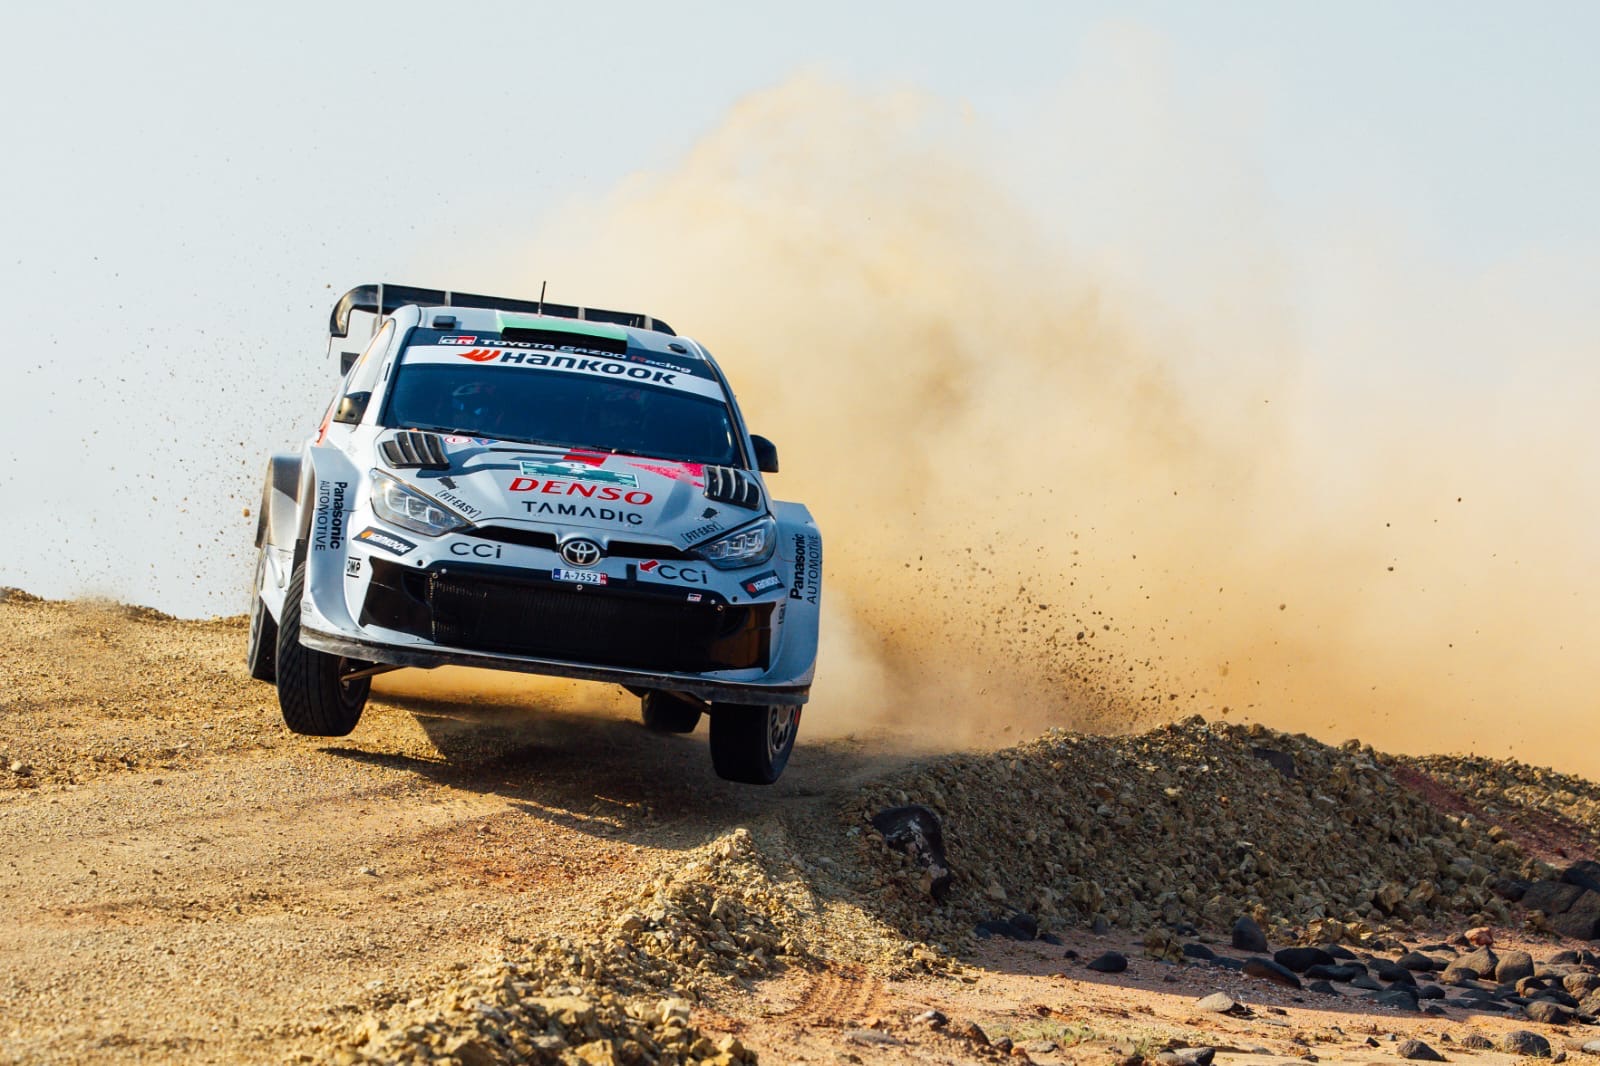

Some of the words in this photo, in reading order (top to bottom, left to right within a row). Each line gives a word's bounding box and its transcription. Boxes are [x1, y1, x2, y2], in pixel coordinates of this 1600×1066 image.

[481, 338, 555, 350] TOYOTA
[560, 345, 627, 359] GAZOO
[631, 355, 692, 374] Racing
[315, 480, 330, 551] AUTOMOTIVE
[330, 481, 348, 550] Panasonic
[509, 477, 653, 505] DENSO
[522, 501, 643, 525] TAMADIC
[564, 571, 598, 583] A-7552
[790, 533, 806, 601] Panasonic
[806, 534, 819, 605] AUTOMOTIVE
